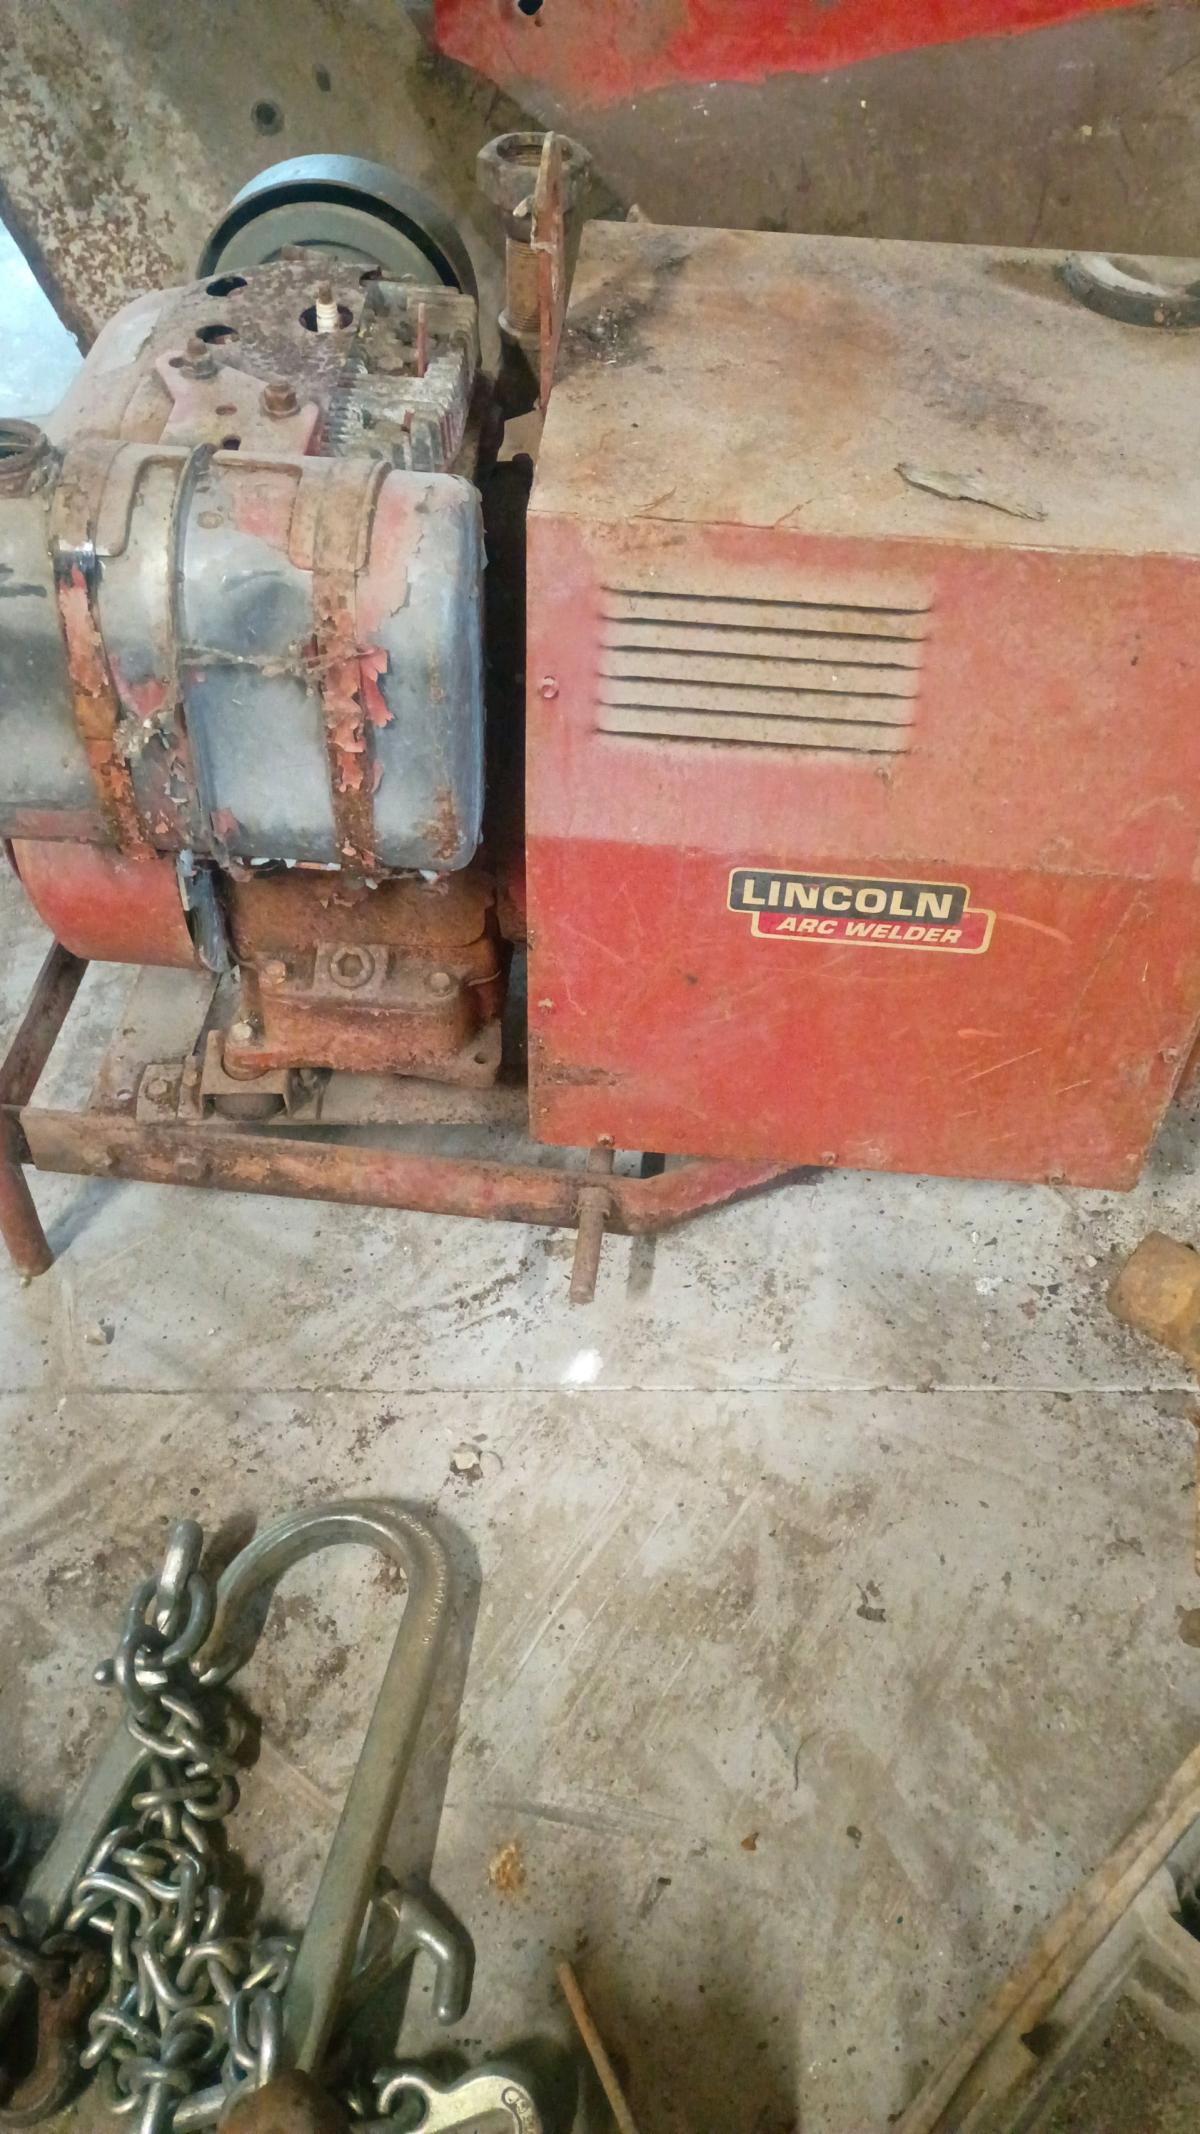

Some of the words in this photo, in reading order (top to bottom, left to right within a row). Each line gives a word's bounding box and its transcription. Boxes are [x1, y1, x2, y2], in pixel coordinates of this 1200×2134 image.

[742, 879, 952, 919] LINCOLN
[776, 917, 838, 935] ARC
[844, 922, 962, 944] WELDER
